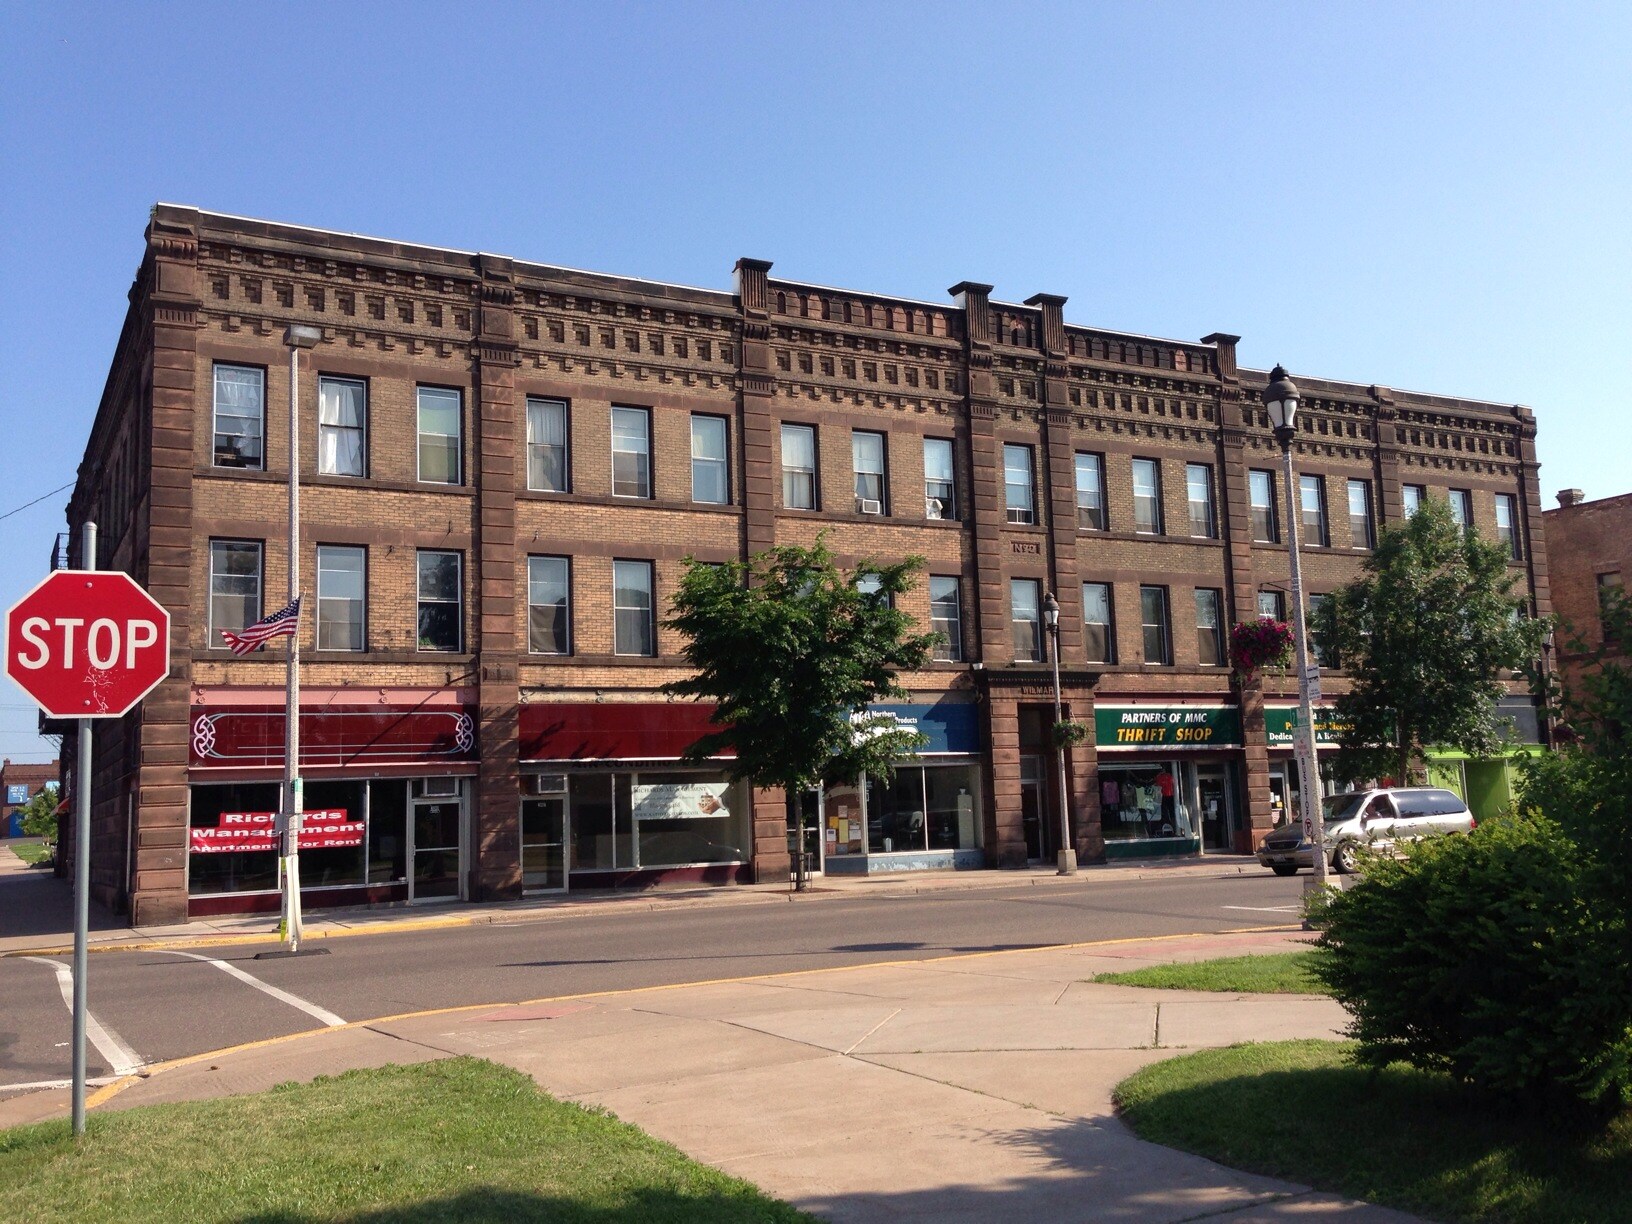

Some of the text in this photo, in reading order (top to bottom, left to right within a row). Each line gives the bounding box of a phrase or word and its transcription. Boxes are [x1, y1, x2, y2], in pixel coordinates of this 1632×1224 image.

[18, 617, 158, 670] STOP
[1022, 686, 1066, 695] WILMARH
[1121, 712, 1208, 724] PARTNERS OF MMC
[1117, 727, 1213, 742] THRIFT SHOP
[1269, 732, 1294, 741] Dedica
[225, 811, 342, 823] Ricrds
[192, 822, 365, 838] Managment
[190, 843, 279, 852] Apartment
[324, 838, 362, 846] Rent
